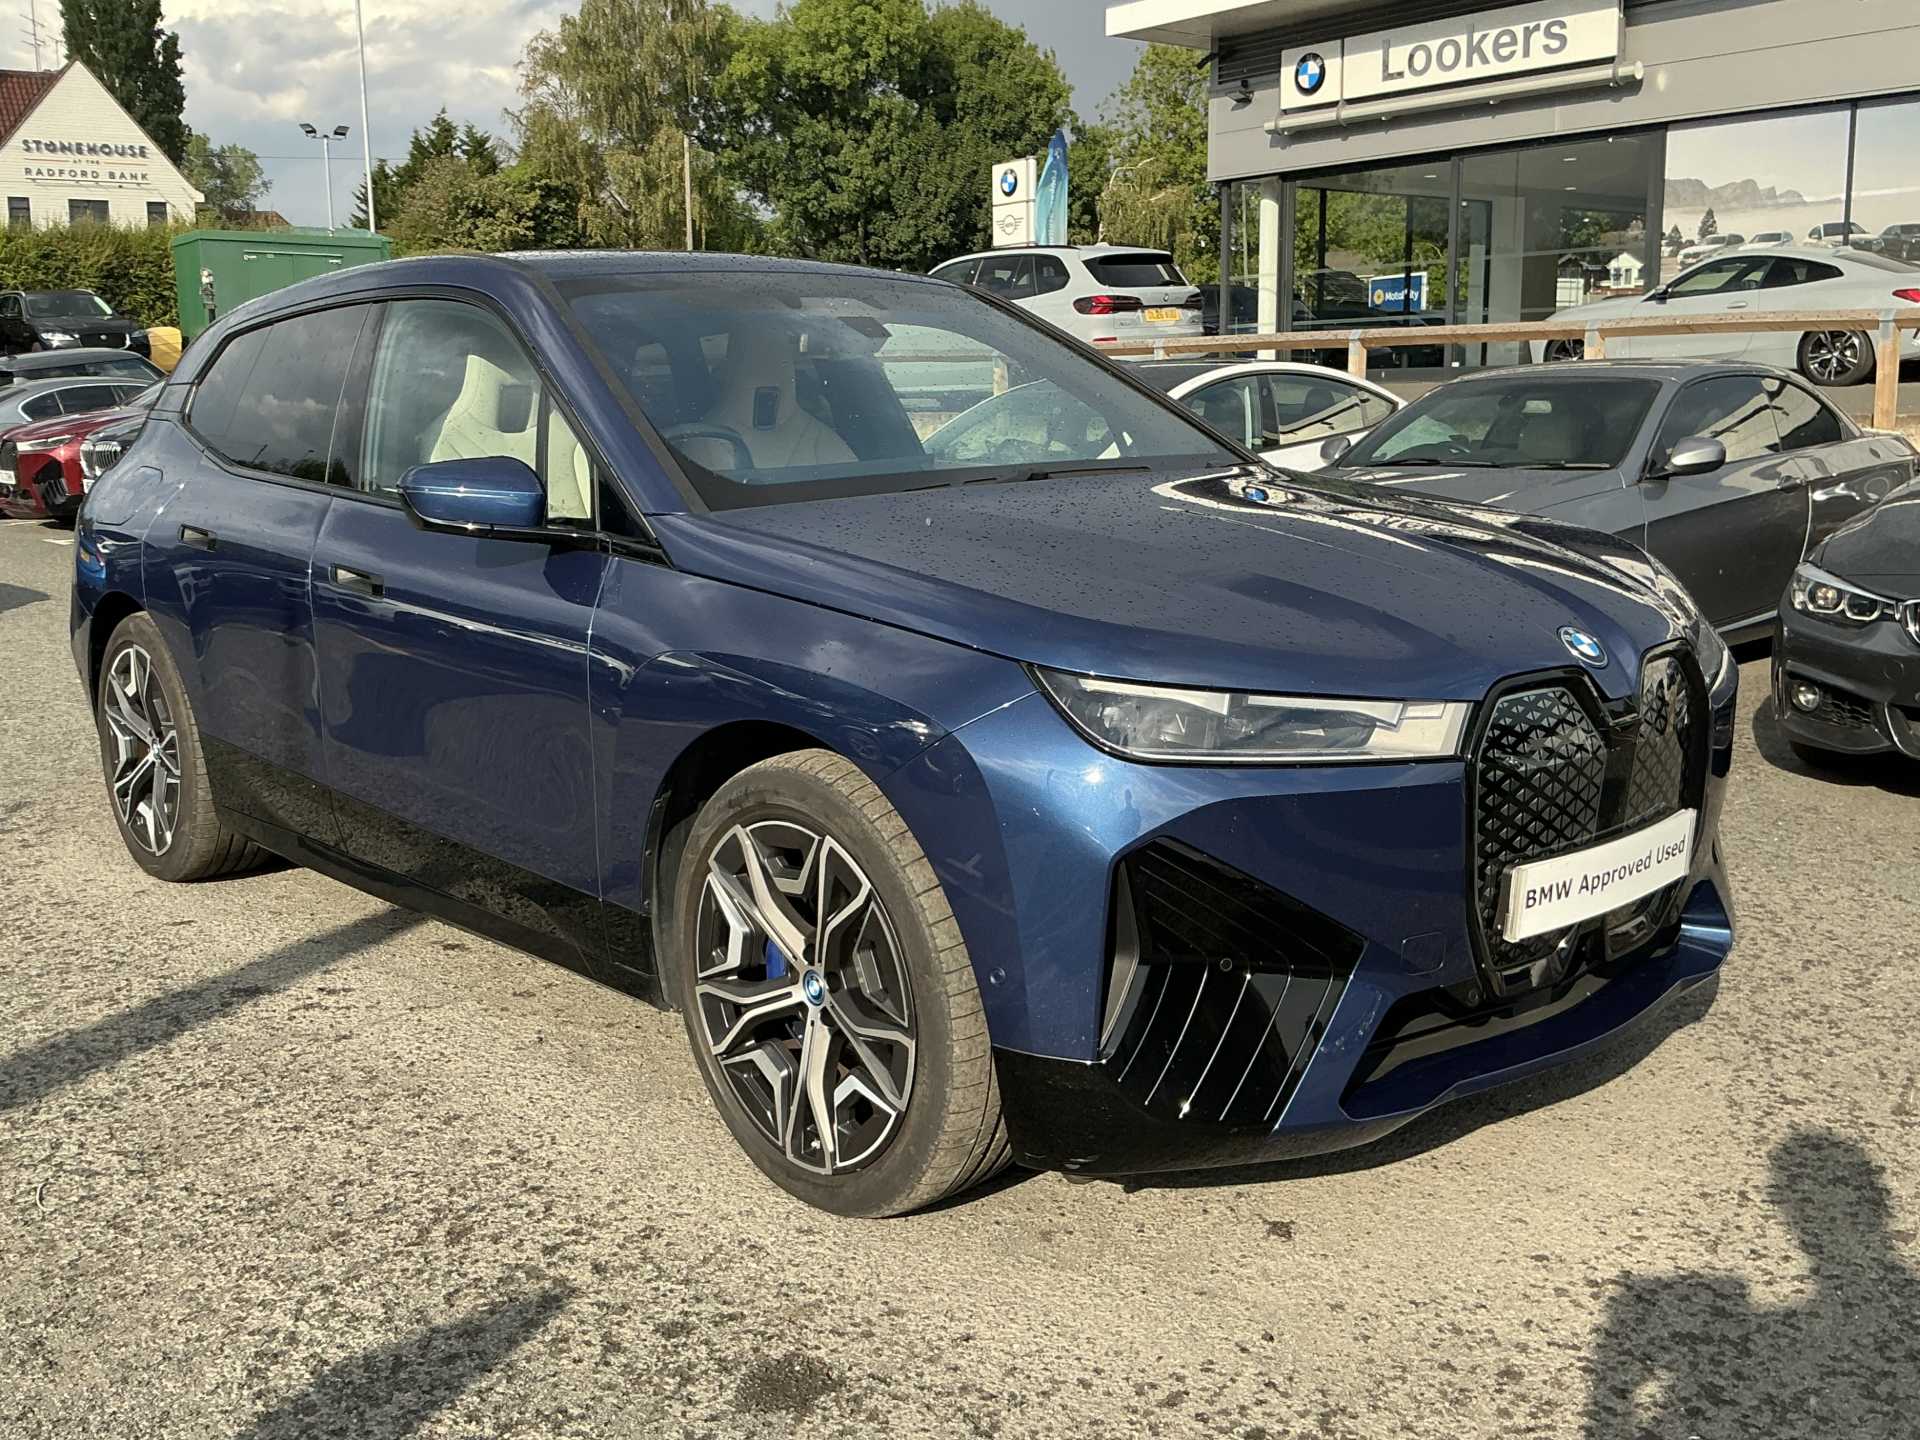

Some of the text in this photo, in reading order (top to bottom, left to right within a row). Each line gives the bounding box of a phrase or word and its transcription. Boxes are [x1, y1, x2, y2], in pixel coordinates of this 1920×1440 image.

[1381, 19, 1568, 82] Lookers
[22, 139, 149, 158] STONEHOUSE
[24, 167, 149, 181] RADFORD BANK
[1525, 834, 1686, 909] BMW Approved Used
